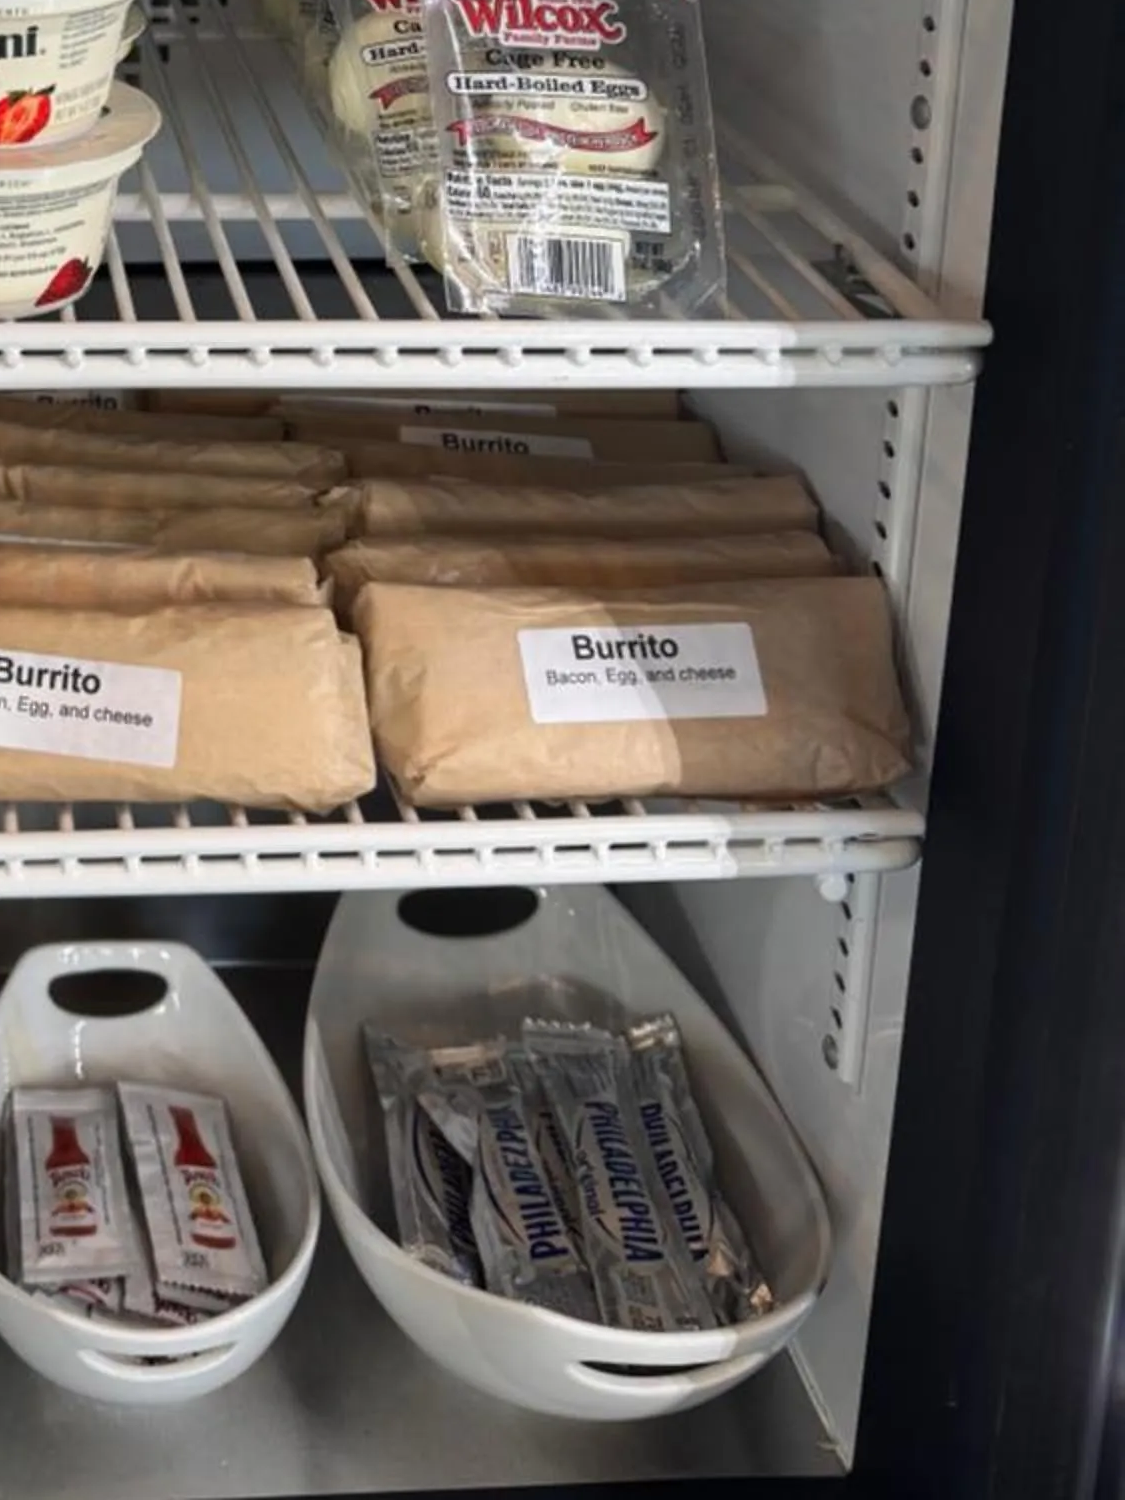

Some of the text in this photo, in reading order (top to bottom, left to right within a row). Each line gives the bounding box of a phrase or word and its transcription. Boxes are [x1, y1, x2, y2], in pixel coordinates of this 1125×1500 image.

[393, 20, 421, 34] Ca
[369, 41, 425, 61] Hard-
[485, 50, 606, 70] Cage Free
[454, 76, 641, 99] Hard-Boiled Eggs
[441, 432, 530, 455] Burrito
[570, 633, 680, 661] Burrito
[545, 668, 603, 687] Bacon,
[645, 666, 676, 683] and
[677, 666, 737, 682] cheese
[16, 695, 54, 718] Egg,
[58, 703, 90, 720] and
[93, 706, 154, 728] cheese
[584, 1101, 664, 1262] PHILADELPHIA
